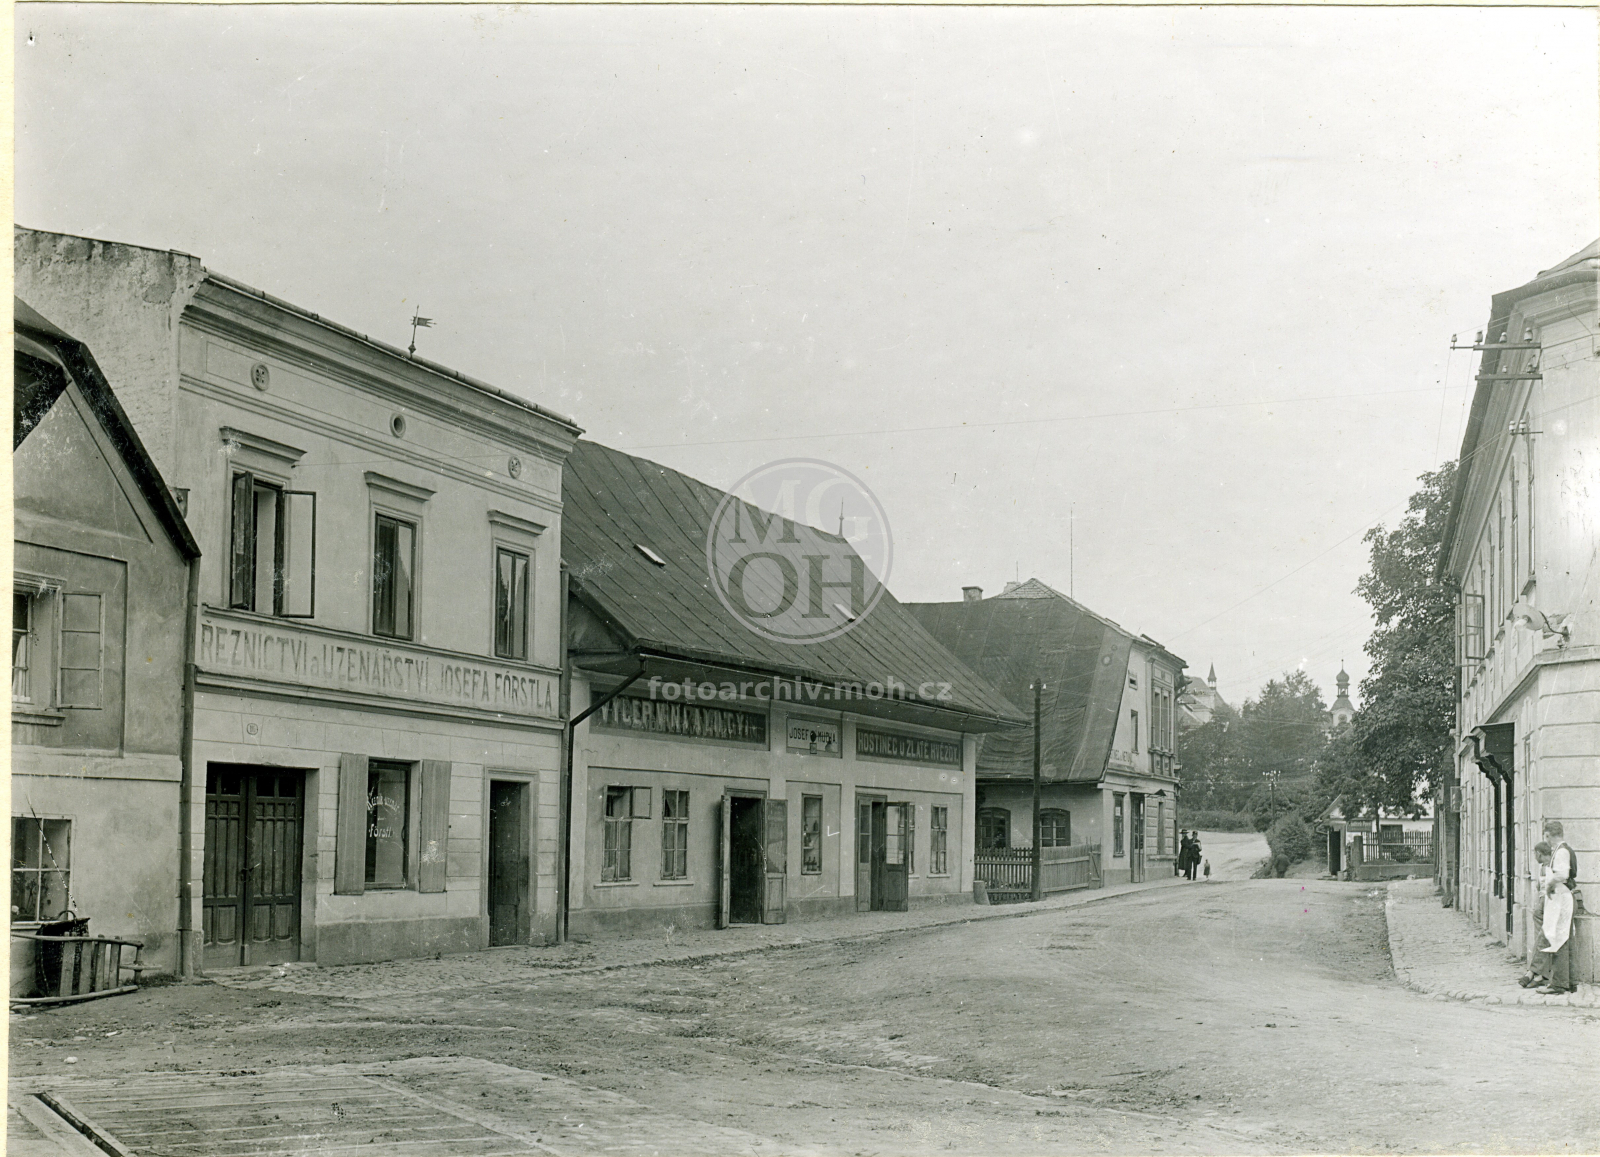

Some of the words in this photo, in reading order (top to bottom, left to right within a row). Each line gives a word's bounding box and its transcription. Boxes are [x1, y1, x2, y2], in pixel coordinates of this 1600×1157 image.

[200, 619, 307, 675] ŘEZNICTVÍ
[310, 656, 319, 676] a
[436, 662, 490, 702] JOSEFA
[789, 727, 809, 740] JOSEF
[857, 731, 898, 755] HOSTINEC
[899, 739, 905, 757] U
